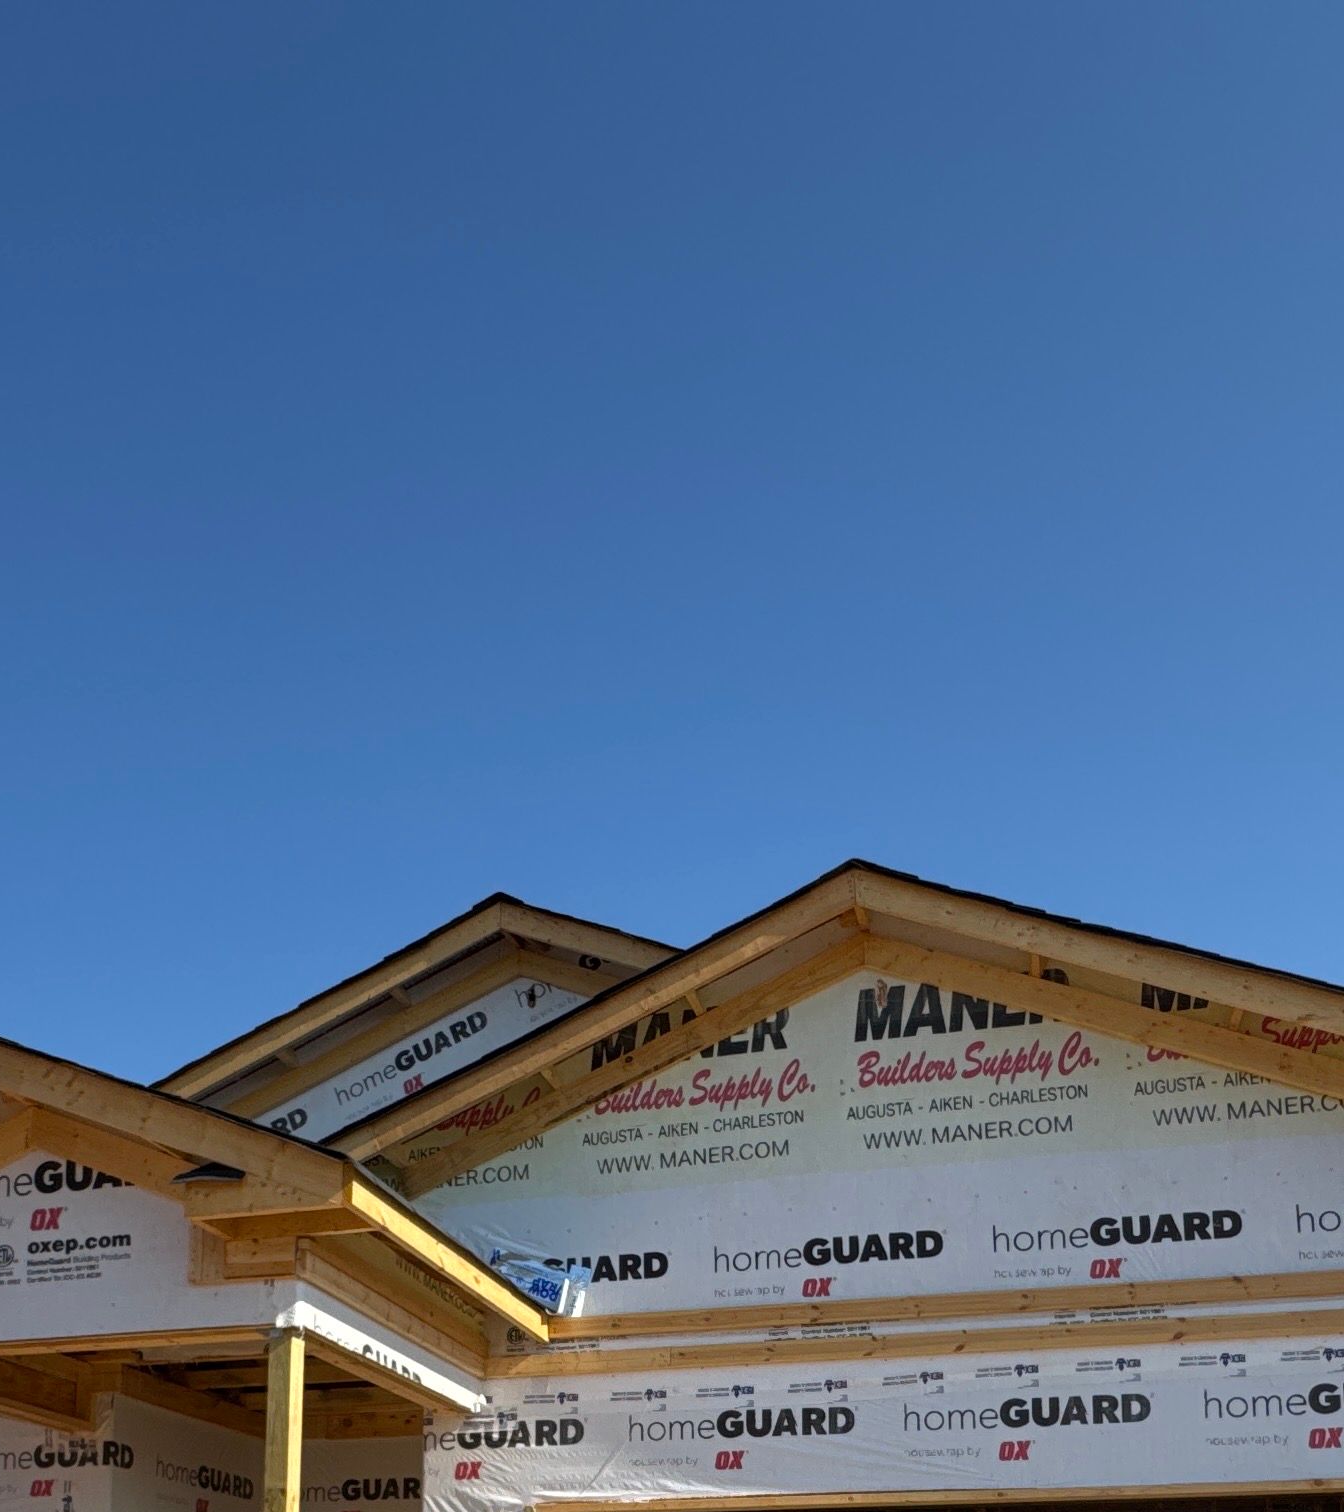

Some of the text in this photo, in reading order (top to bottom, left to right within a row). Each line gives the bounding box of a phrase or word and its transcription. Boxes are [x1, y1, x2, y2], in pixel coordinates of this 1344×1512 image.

[334, 1011, 488, 1107] homeGUARD
[857, 1030, 1100, 1089] Builders Supply Co.
[402, 1073, 425, 1096] OX
[688, 1067, 776, 1114] Supply
[777, 1058, 816, 1102] Co.
[1134, 1077, 1206, 1097] AUGUSTA
[846, 1083, 1089, 1122] AUGUSTA AIKEN CHARLESTON
[1153, 1104, 1221, 1127] WWW.
[582, 1109, 805, 1147] AUGUSTA AIKEN CHARLESTON
[863, 1115, 1074, 1150] WWW. MANER.COM
[596, 1139, 790, 1175] WWW. MANER.COM
[30, 1207, 63, 1231] OX
[992, 1209, 1243, 1254] homeGUARD
[27, 1233, 132, 1255] oxep.com
[713, 1228, 945, 1275] homeGUARD
[1089, 1258, 1123, 1279] OX
[801, 1277, 832, 1298] OX
[628, 1407, 856, 1442] homeGUARD
[903, 1392, 1152, 1432] homeGUARD
[998, 1440, 1031, 1461] OX
[1308, 1426, 1343, 1449] OX
[454, 1461, 481, 1481] OX
[714, 1450, 744, 1470] OX
[29, 1480, 55, 1497] OX
[156, 1457, 254, 1500] homeGUARD
